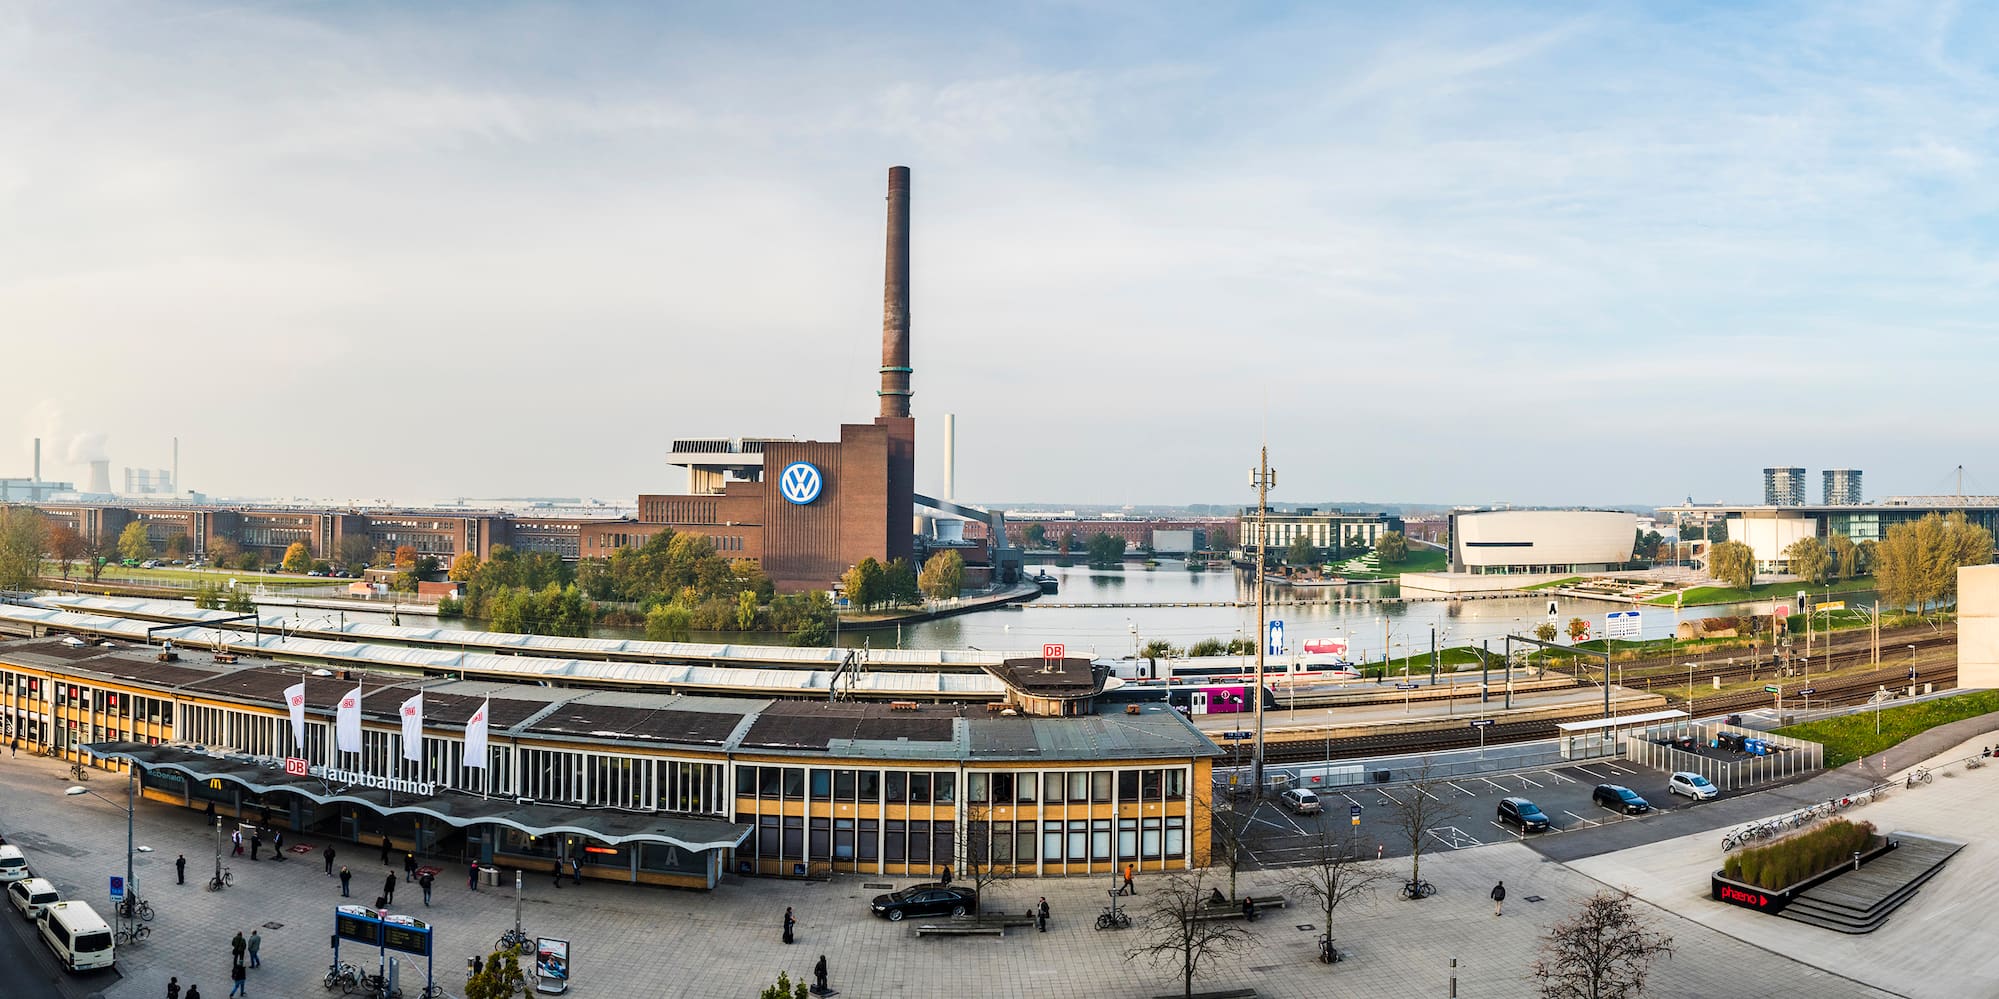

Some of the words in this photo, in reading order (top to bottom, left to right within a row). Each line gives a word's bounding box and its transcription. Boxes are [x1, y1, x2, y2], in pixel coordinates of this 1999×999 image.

[782, 463, 820, 502] VW
[1045, 646, 1062, 657] DB
[287, 759, 305, 774] DB
[1721, 885, 1757, 905] phaeno
